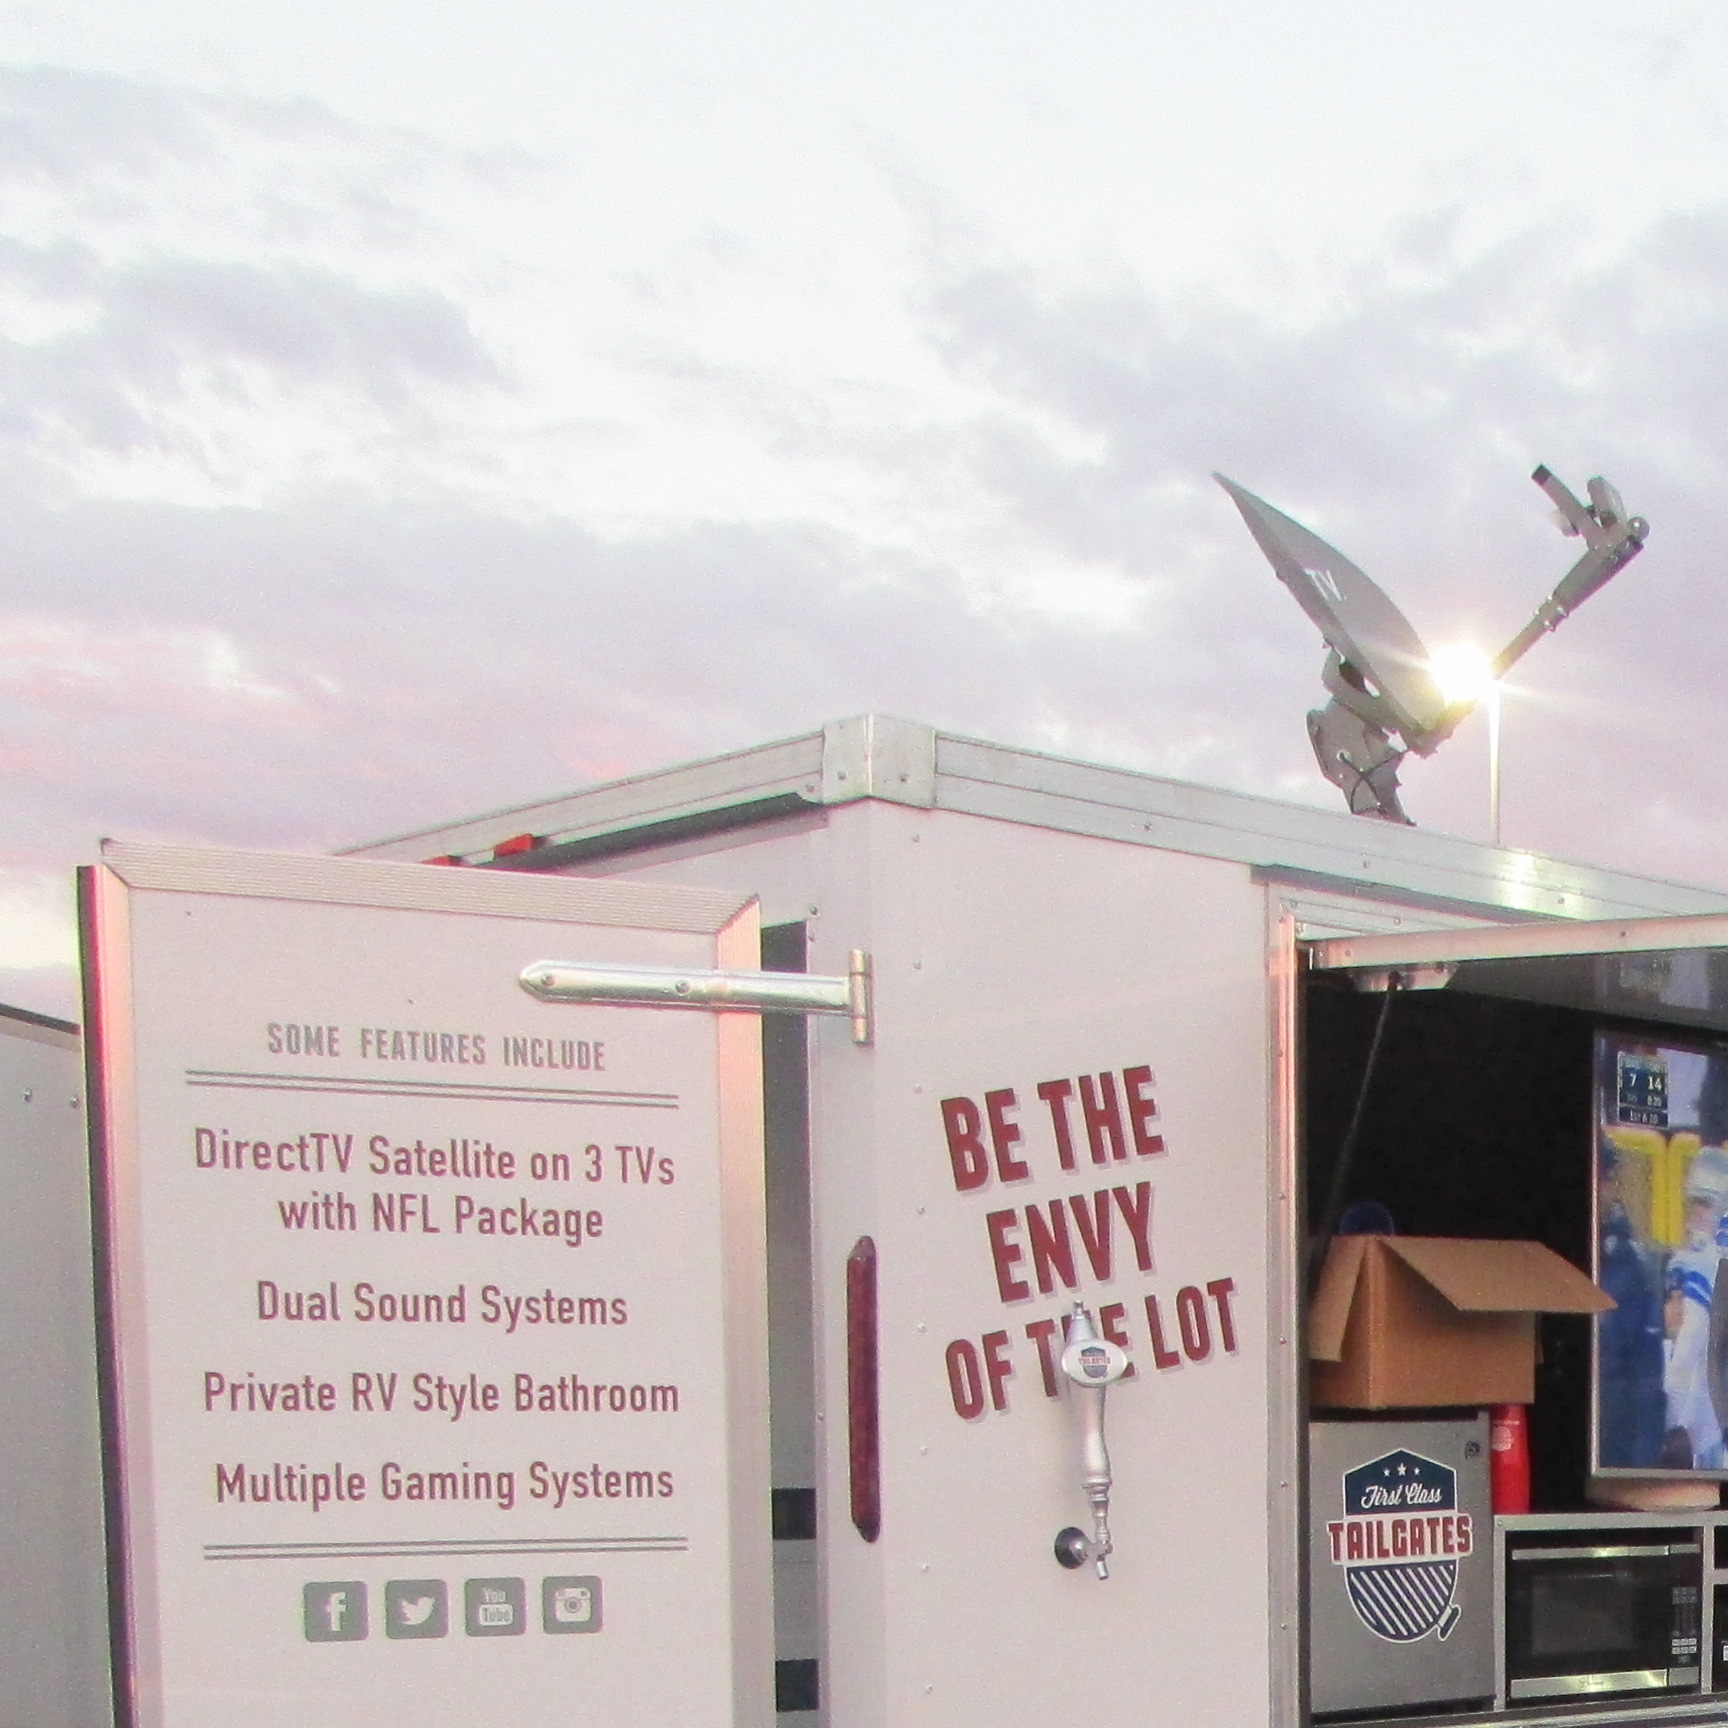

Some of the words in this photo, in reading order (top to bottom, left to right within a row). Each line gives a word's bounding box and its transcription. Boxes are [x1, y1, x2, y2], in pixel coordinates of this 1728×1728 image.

[268, 1022, 341, 1057] SOME
[360, 1028, 488, 1065] FEATURES
[503, 1036, 606, 1071] INCLUDE
[1629, 1073, 1637, 1087] 7
[1648, 1076, 1662, 1091] 14
[940, 1088, 1030, 1192] BE
[1037, 1065, 1166, 1171] THE
[194, 1127, 354, 1173] DirectTV
[369, 1135, 516, 1179] Satellite
[530, 1151, 570, 1182] on
[585, 1144, 603, 1183] 3
[615, 1145, 675, 1186] TVs
[278, 1190, 356, 1231] with
[372, 1192, 440, 1234] NFL
[455, 1194, 604, 1249] Package
[986, 1181, 1153, 1303] ENVY
[257, 1280, 341, 1322] Dual
[354, 1281, 466, 1324] Sound
[481, 1285, 628, 1334] Systems
[945, 1330, 1012, 1420] OF
[1026, 1303, 1137, 1397] TE
[1145, 1277, 1237, 1371] LOT
[204, 1371, 337, 1412] Private
[351, 1371, 398, 1412] RV
[412, 1372, 500, 1423] Style
[514, 1373, 679, 1412] Bathroom
[216, 1463, 366, 1512] Multiple
[381, 1462, 515, 1510] Gaming
[529, 1461, 675, 1509] Systems
[1361, 1483, 1402, 1509] First
[1403, 1482, 1443, 1505] Class
[1328, 1515, 1470, 1561] TAILGATES
